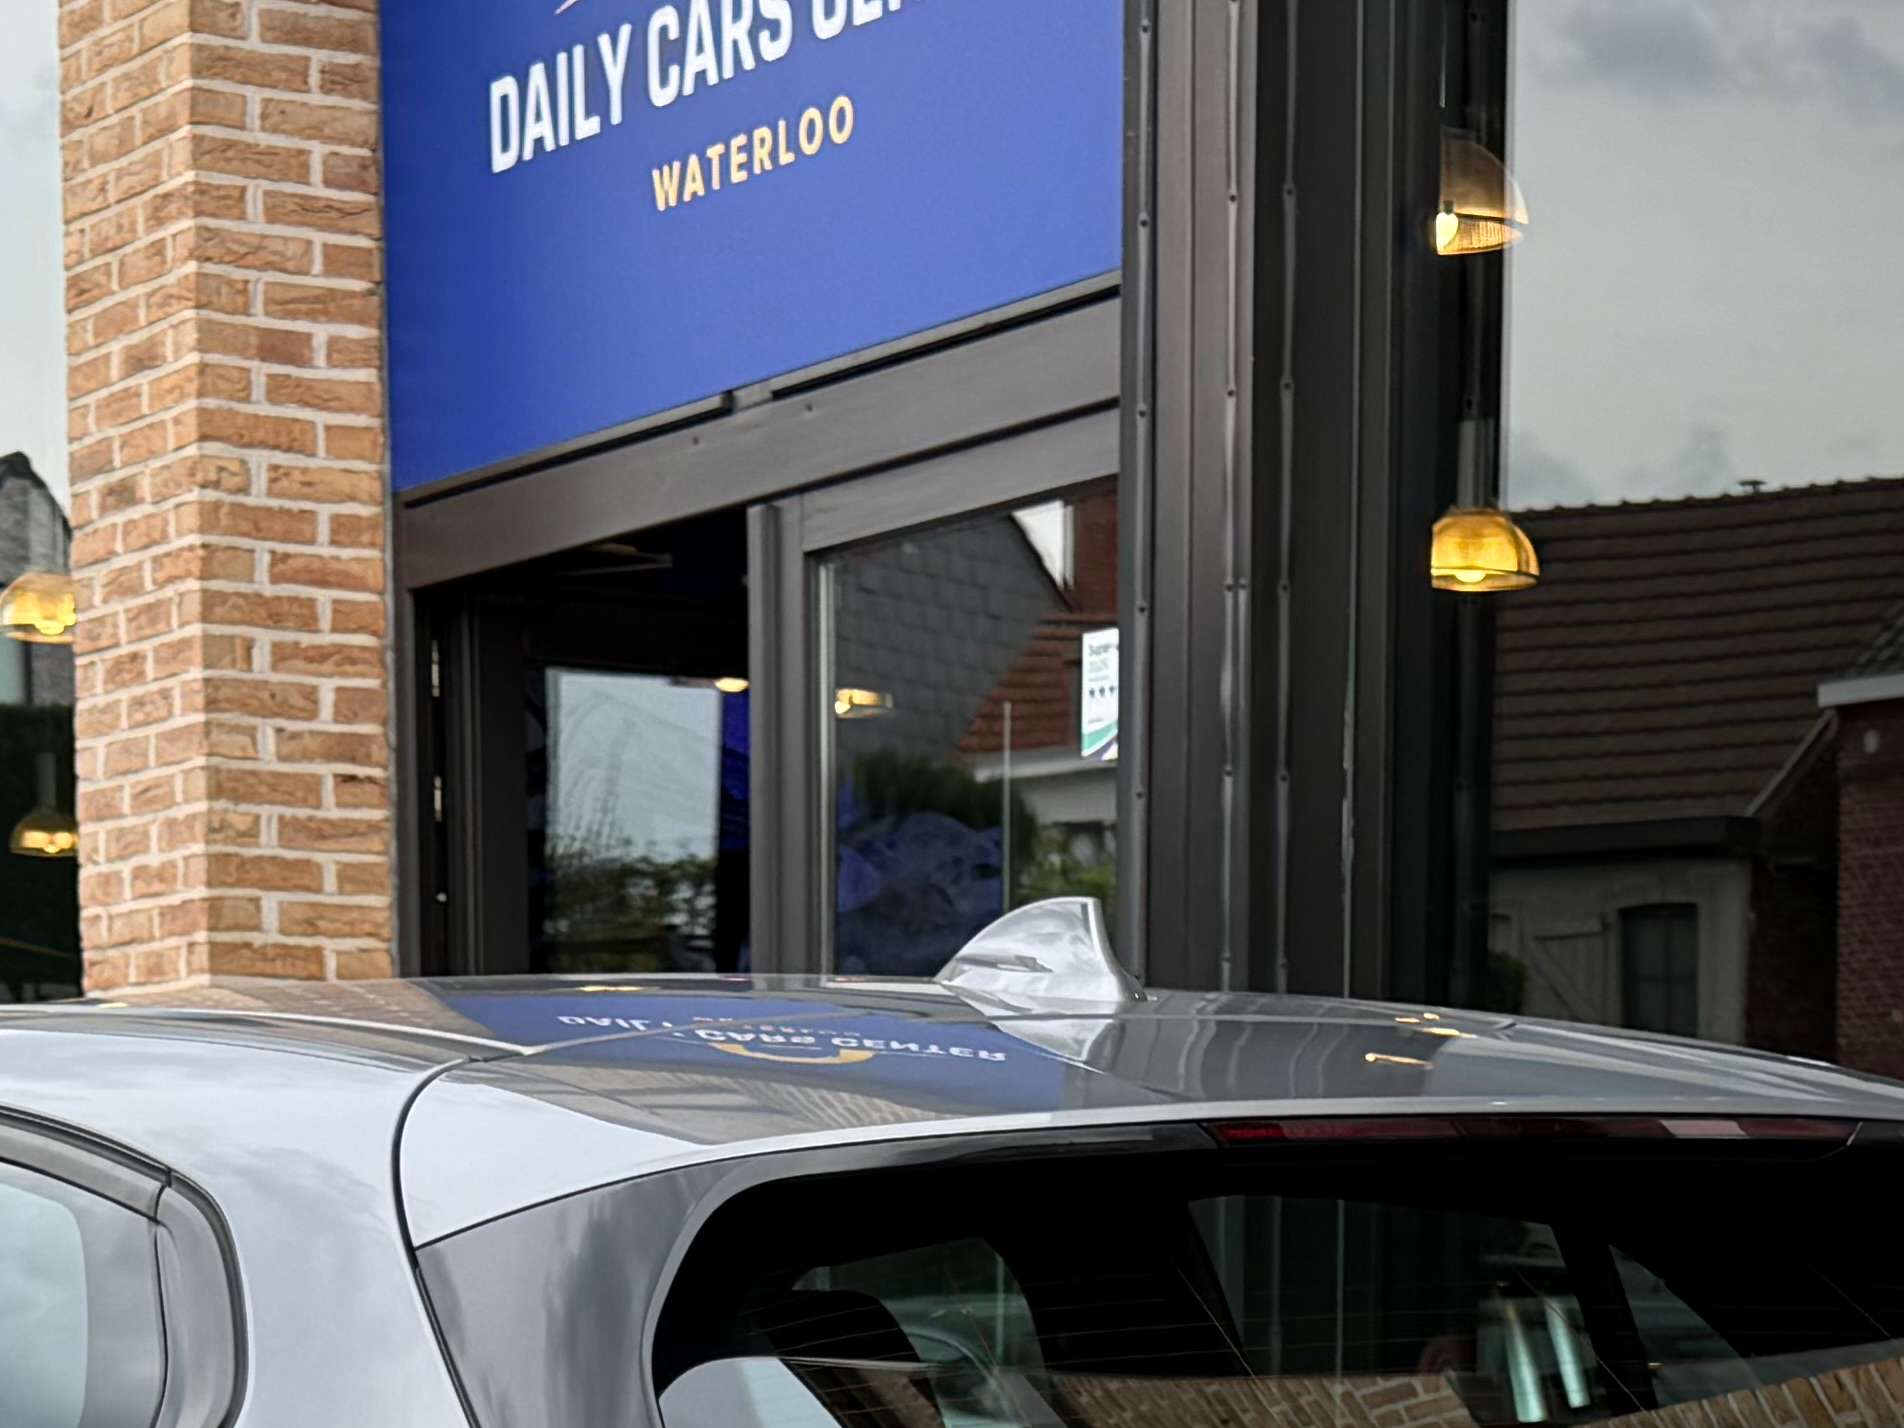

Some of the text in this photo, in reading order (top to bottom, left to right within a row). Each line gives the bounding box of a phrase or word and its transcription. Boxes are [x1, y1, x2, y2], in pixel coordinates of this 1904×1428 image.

[490, 0, 793, 174] DAILY CARS
[651, 95, 855, 212] WATERLOO
